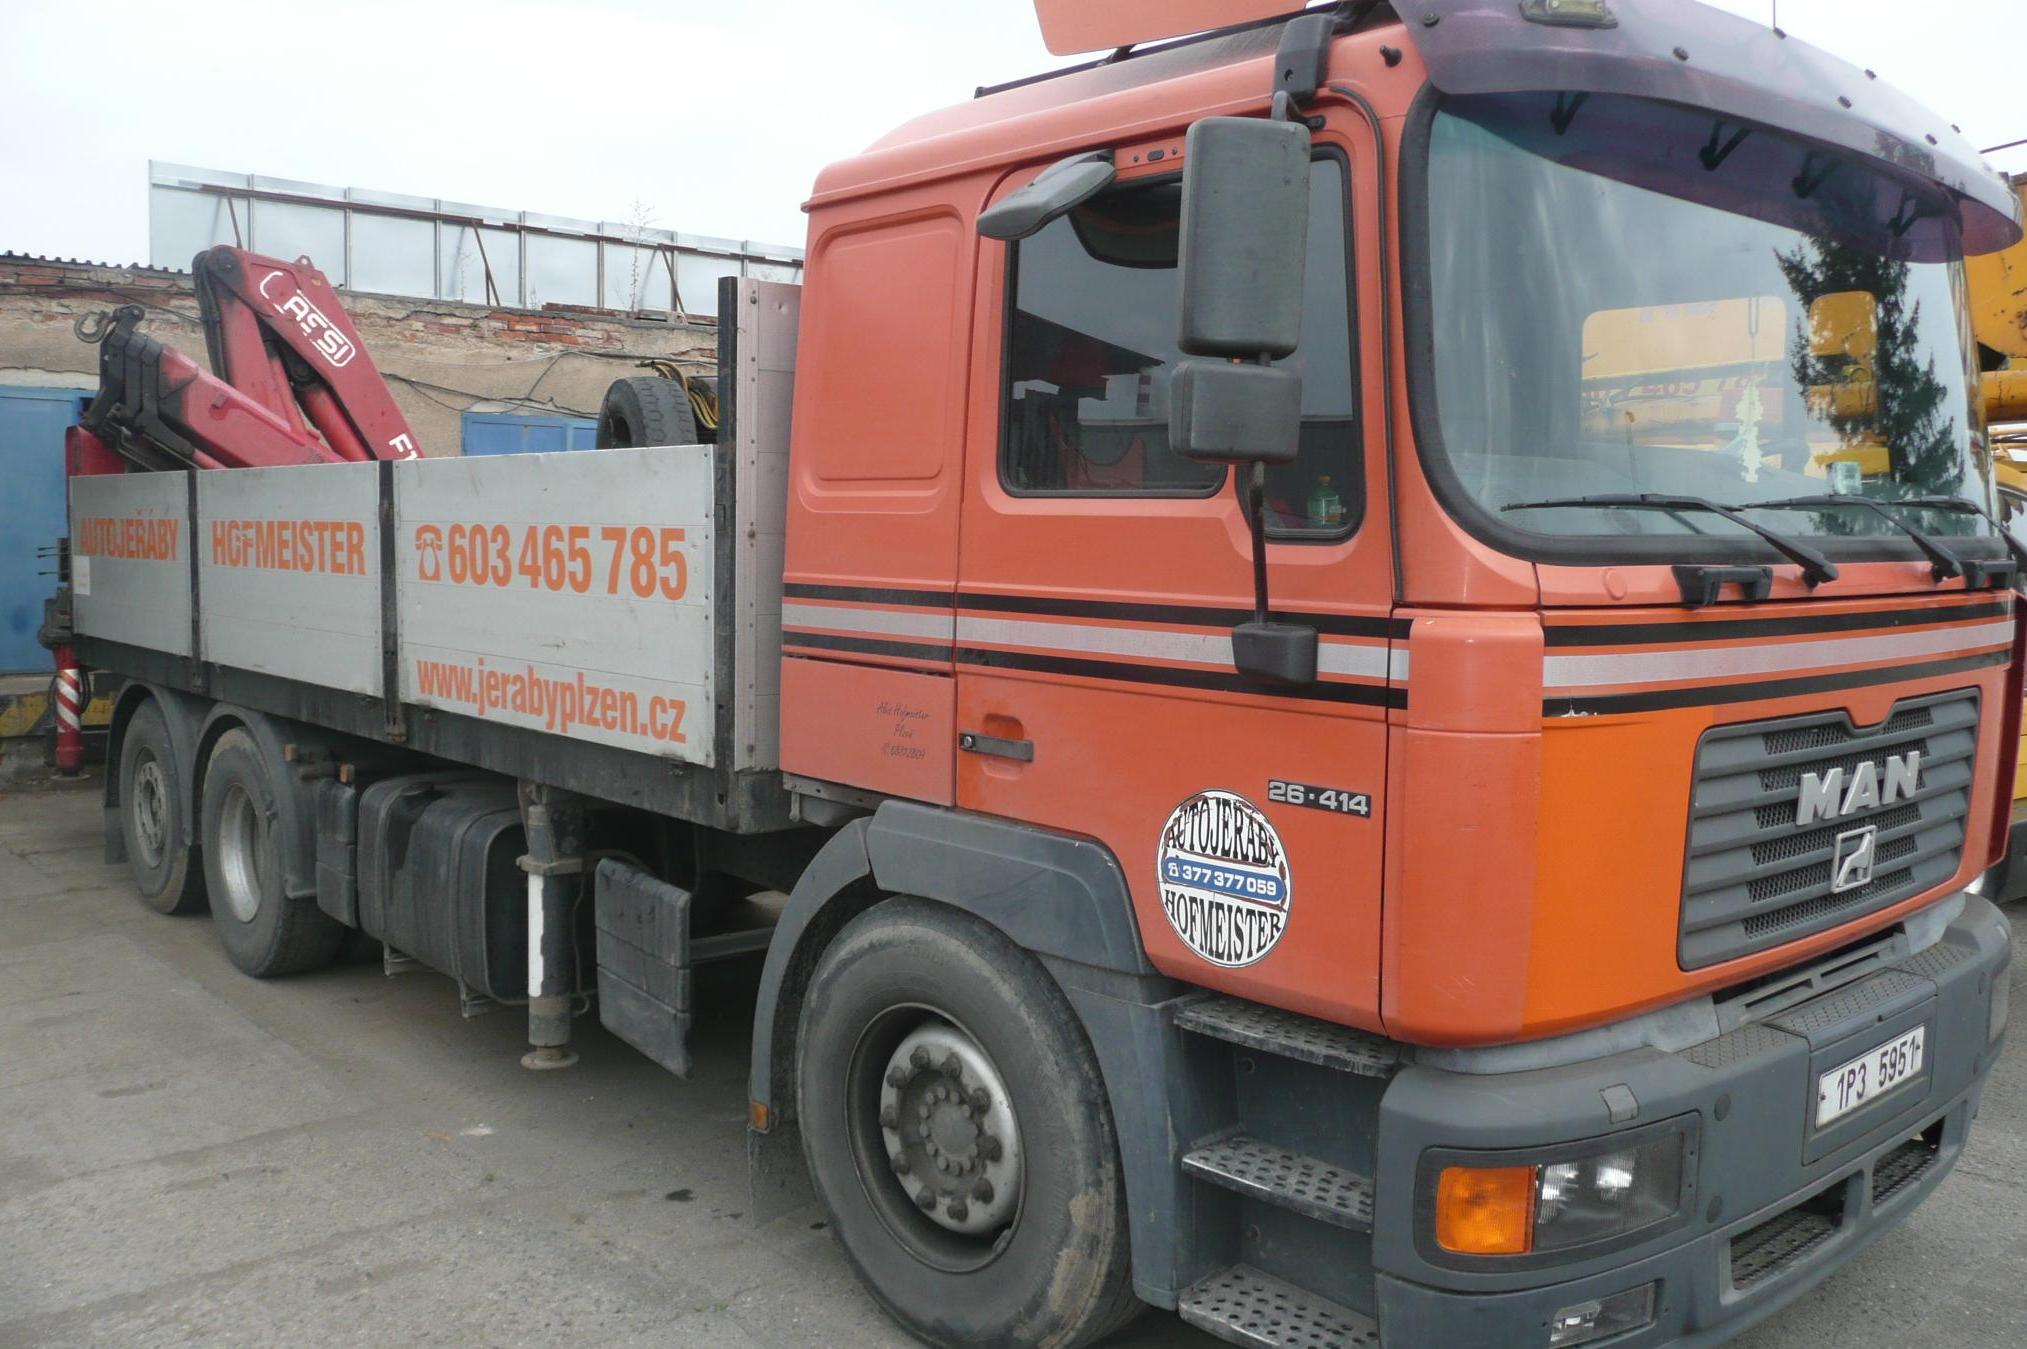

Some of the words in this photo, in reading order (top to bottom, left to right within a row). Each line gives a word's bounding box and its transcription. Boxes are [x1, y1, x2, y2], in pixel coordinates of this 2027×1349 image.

[448, 523, 511, 587] 603
[518, 525, 592, 593] 465
[601, 526, 687, 600] 785
[416, 656, 686, 744] www.jerabyplzen.cz
[1796, 750, 1921, 826] MAN
[1182, 864, 1212, 882] 377
[1214, 871, 1245, 889] 377
[1246, 879, 1277, 896] 059
[1164, 889, 1282, 962] HOFMEISTER
[1837, 1062, 1867, 1110] 1P3
